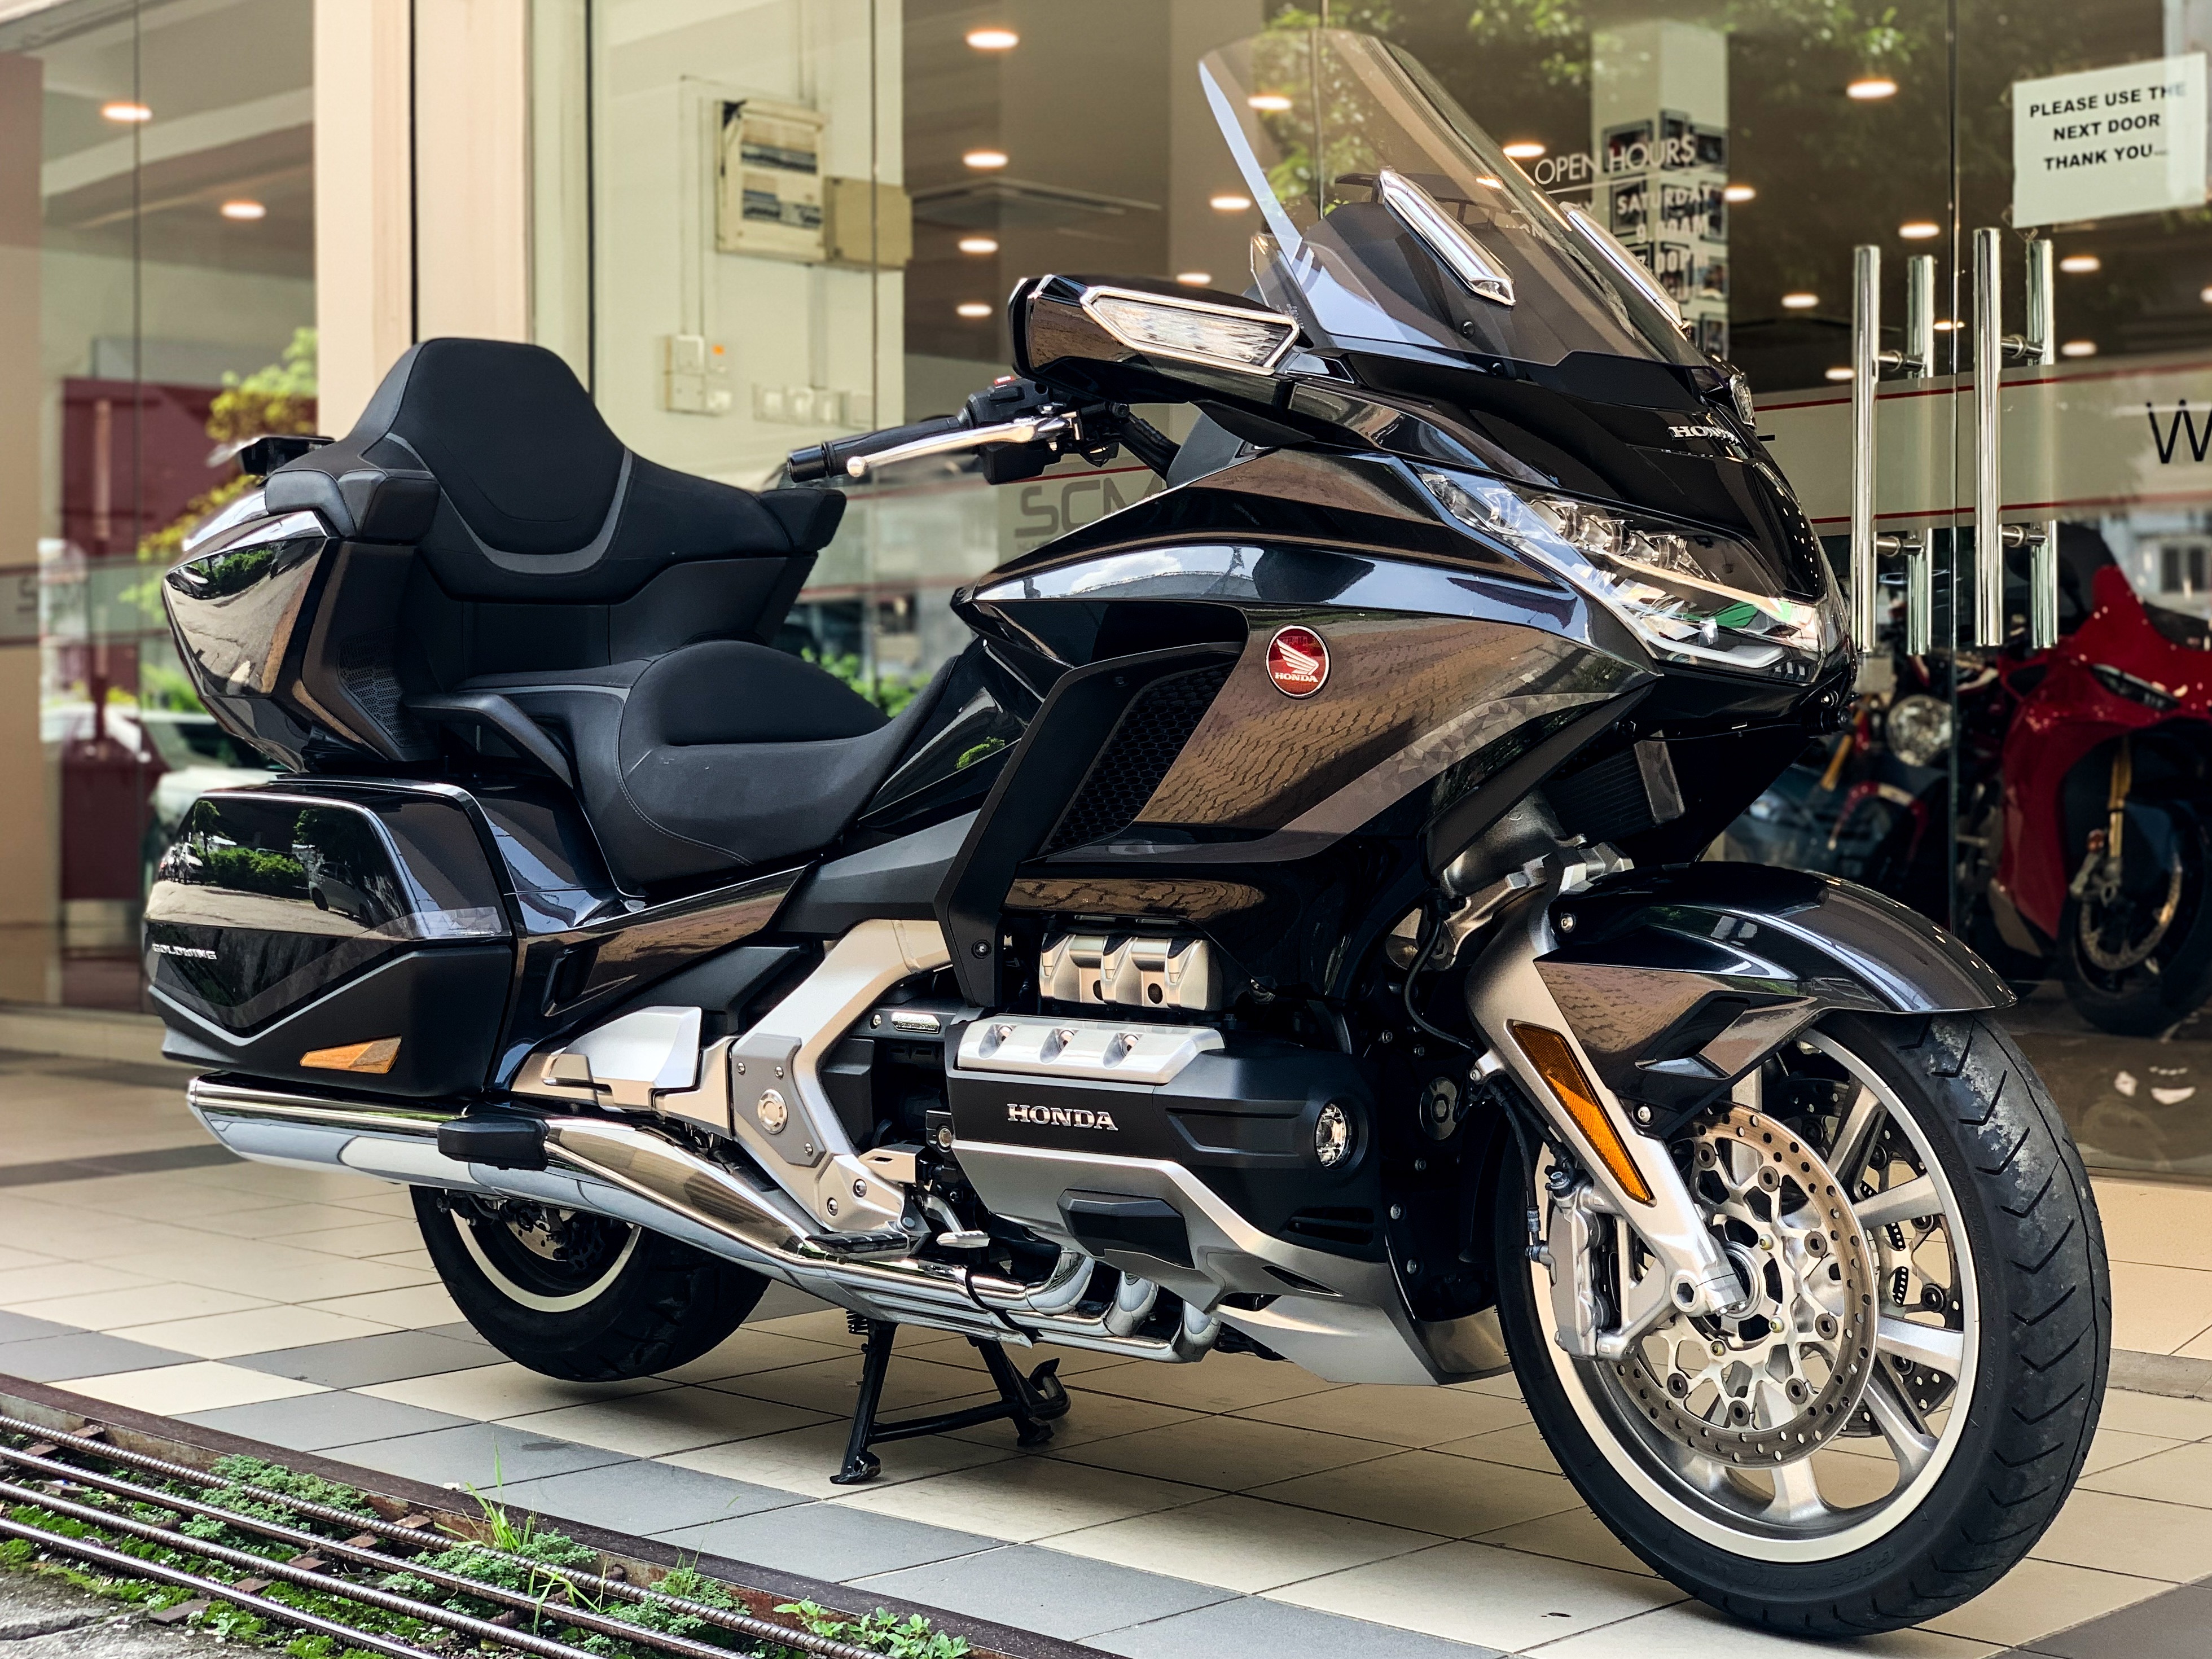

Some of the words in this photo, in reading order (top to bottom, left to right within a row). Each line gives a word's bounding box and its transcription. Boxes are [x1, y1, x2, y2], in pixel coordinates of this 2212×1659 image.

[2030, 95, 2098, 117] PLEASE
[2105, 89, 2141, 107] USE
[2148, 81, 2187, 100] THE
[2053, 122, 2101, 141] NEXT
[2108, 113, 2161, 133] DOOR
[1534, 152, 1600, 185] OPEN
[1609, 135, 1696, 170] HOURS
[2043, 150, 2108, 171] THANK
[1617, 185, 1711, 216] SATURDAY
[1275, 673, 1318, 682] HONDA
[152, 943, 217, 960] GOLDWING
[1007, 1103, 1119, 1131] HONDA
